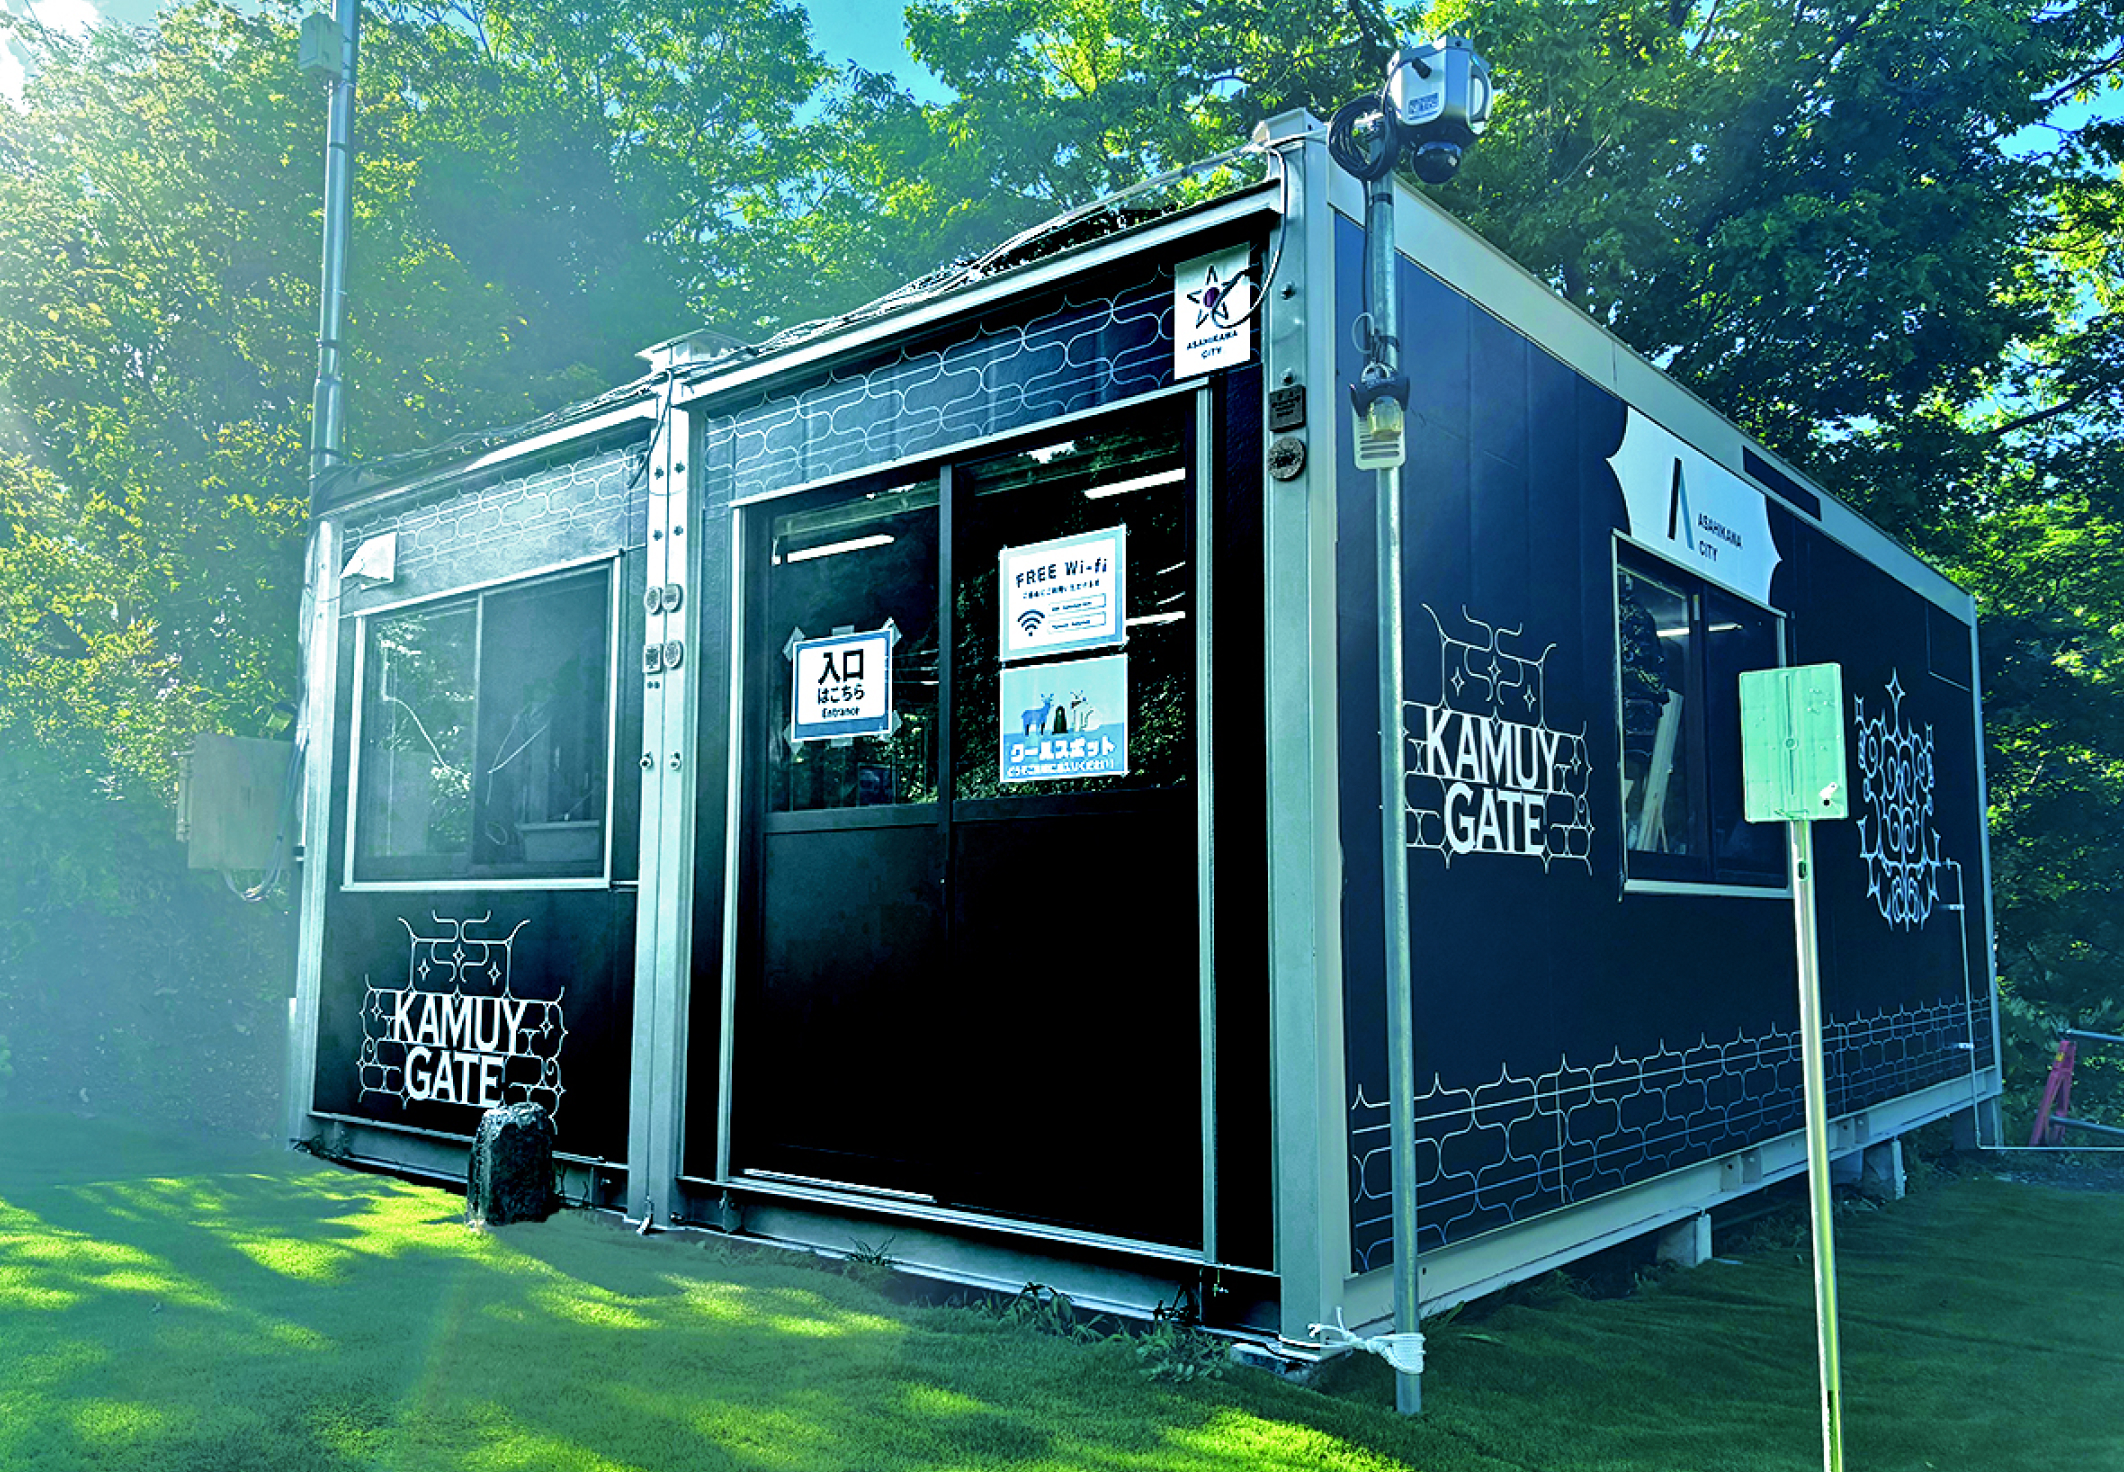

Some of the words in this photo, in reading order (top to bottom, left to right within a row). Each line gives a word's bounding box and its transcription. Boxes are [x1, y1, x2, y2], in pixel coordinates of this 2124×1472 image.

[1201, 346, 1222, 359] CITY
[1699, 541, 1718, 561] CITY
[1015, 563, 1057, 588] FREE
[1064, 556, 1108, 576] Wi-fi
[817, 648, 864, 685] 入口
[817, 683, 865, 705] はこちら
[1010, 735, 1116, 763] クールスポット
[1425, 705, 1561, 794] KAMUY
[1444, 781, 1546, 856] GATE
[393, 990, 528, 1056] KAMUY
[405, 1045, 504, 1109] GATE
